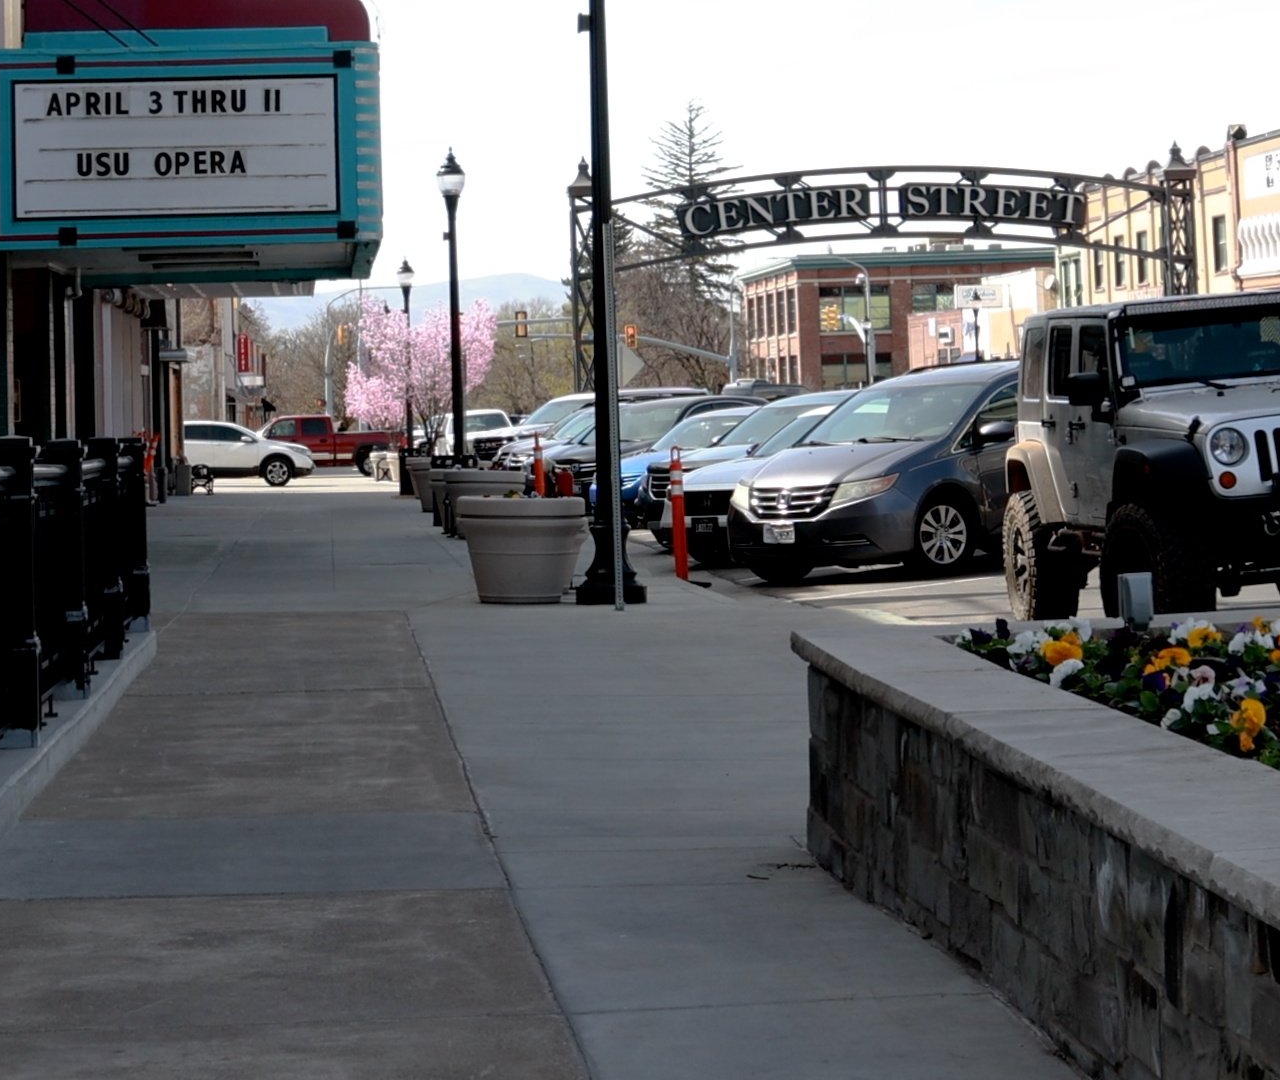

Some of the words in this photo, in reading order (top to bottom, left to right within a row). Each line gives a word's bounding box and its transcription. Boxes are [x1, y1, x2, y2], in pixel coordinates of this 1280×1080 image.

[46, 91, 130, 116] APRIL
[148, 90, 163, 114] 3
[173, 89, 247, 114] THRU
[76, 151, 130, 177] USU
[154, 150, 247, 176] OPERA
[684, 187, 869, 236] CENTER
[907, 185, 1086, 224] STREET
